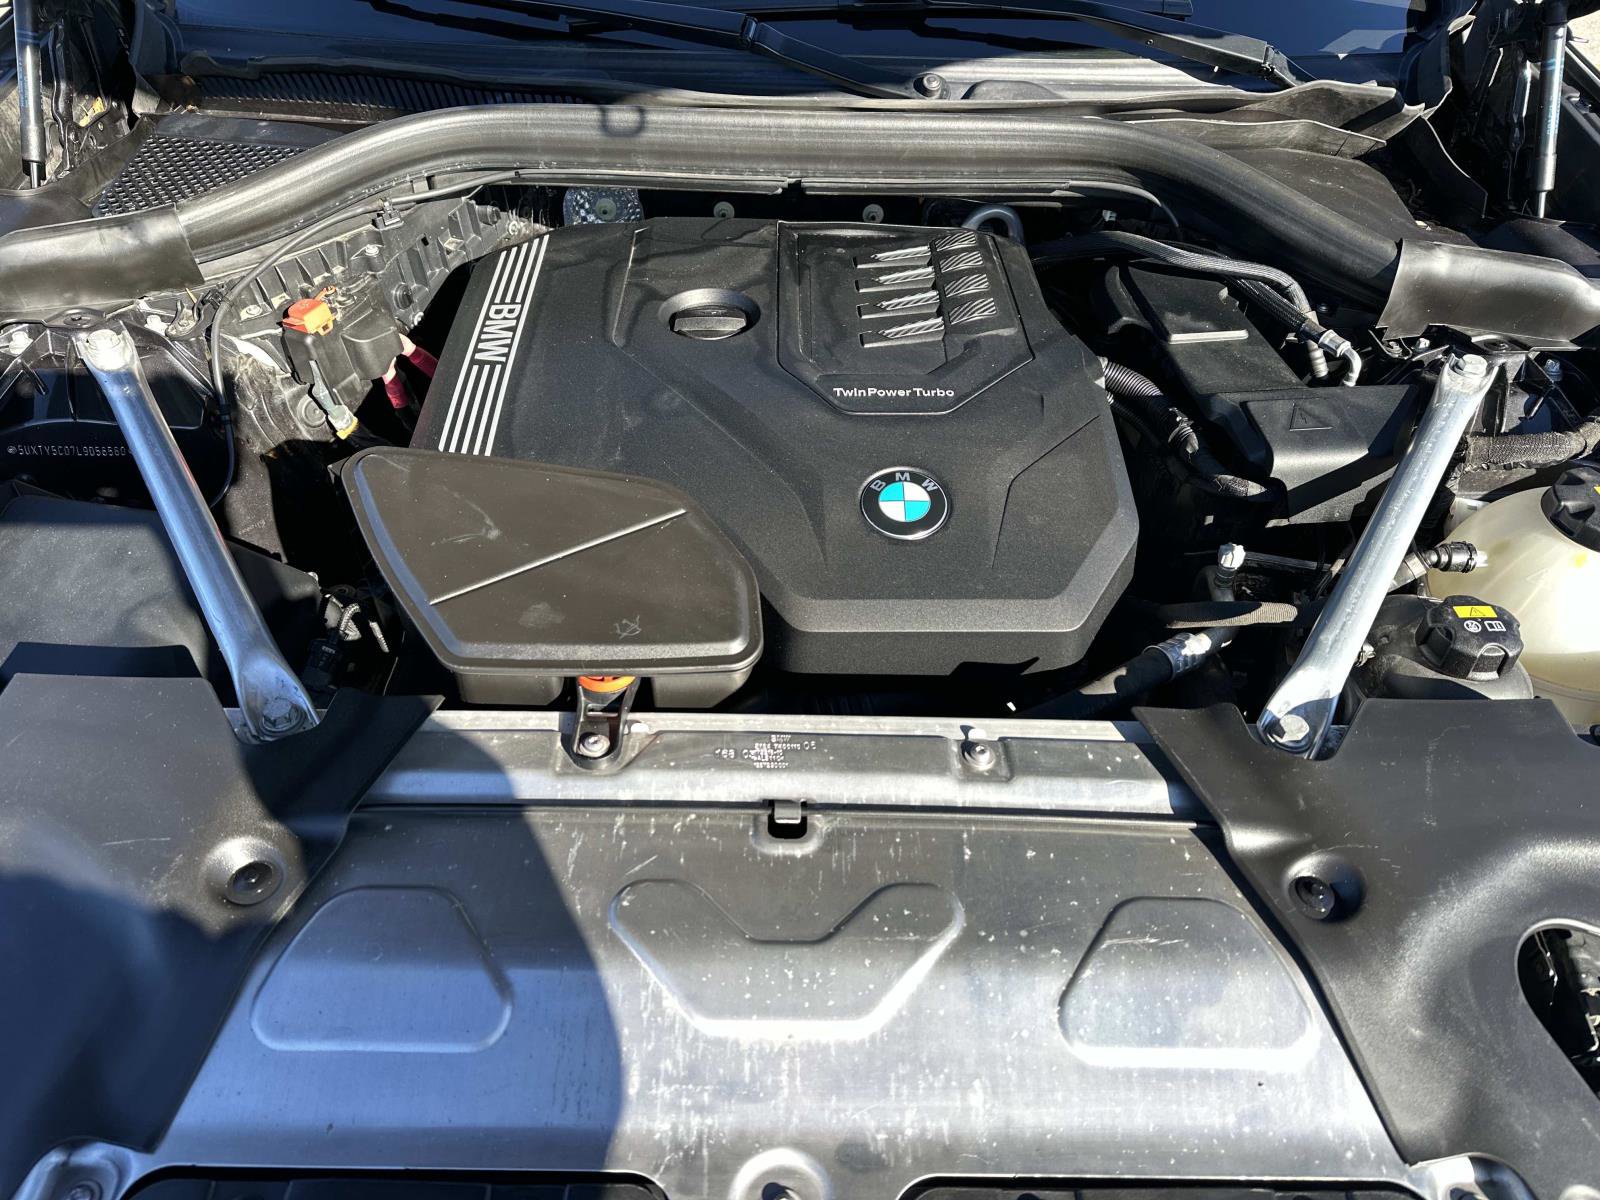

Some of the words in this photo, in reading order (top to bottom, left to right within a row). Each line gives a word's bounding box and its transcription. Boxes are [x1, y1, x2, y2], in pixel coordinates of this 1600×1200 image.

[474, 303, 521, 363] BMW
[832, 387, 912, 397] TwinPower
[912, 387, 955, 397] Turbo
[869, 472, 938, 492] BMW
